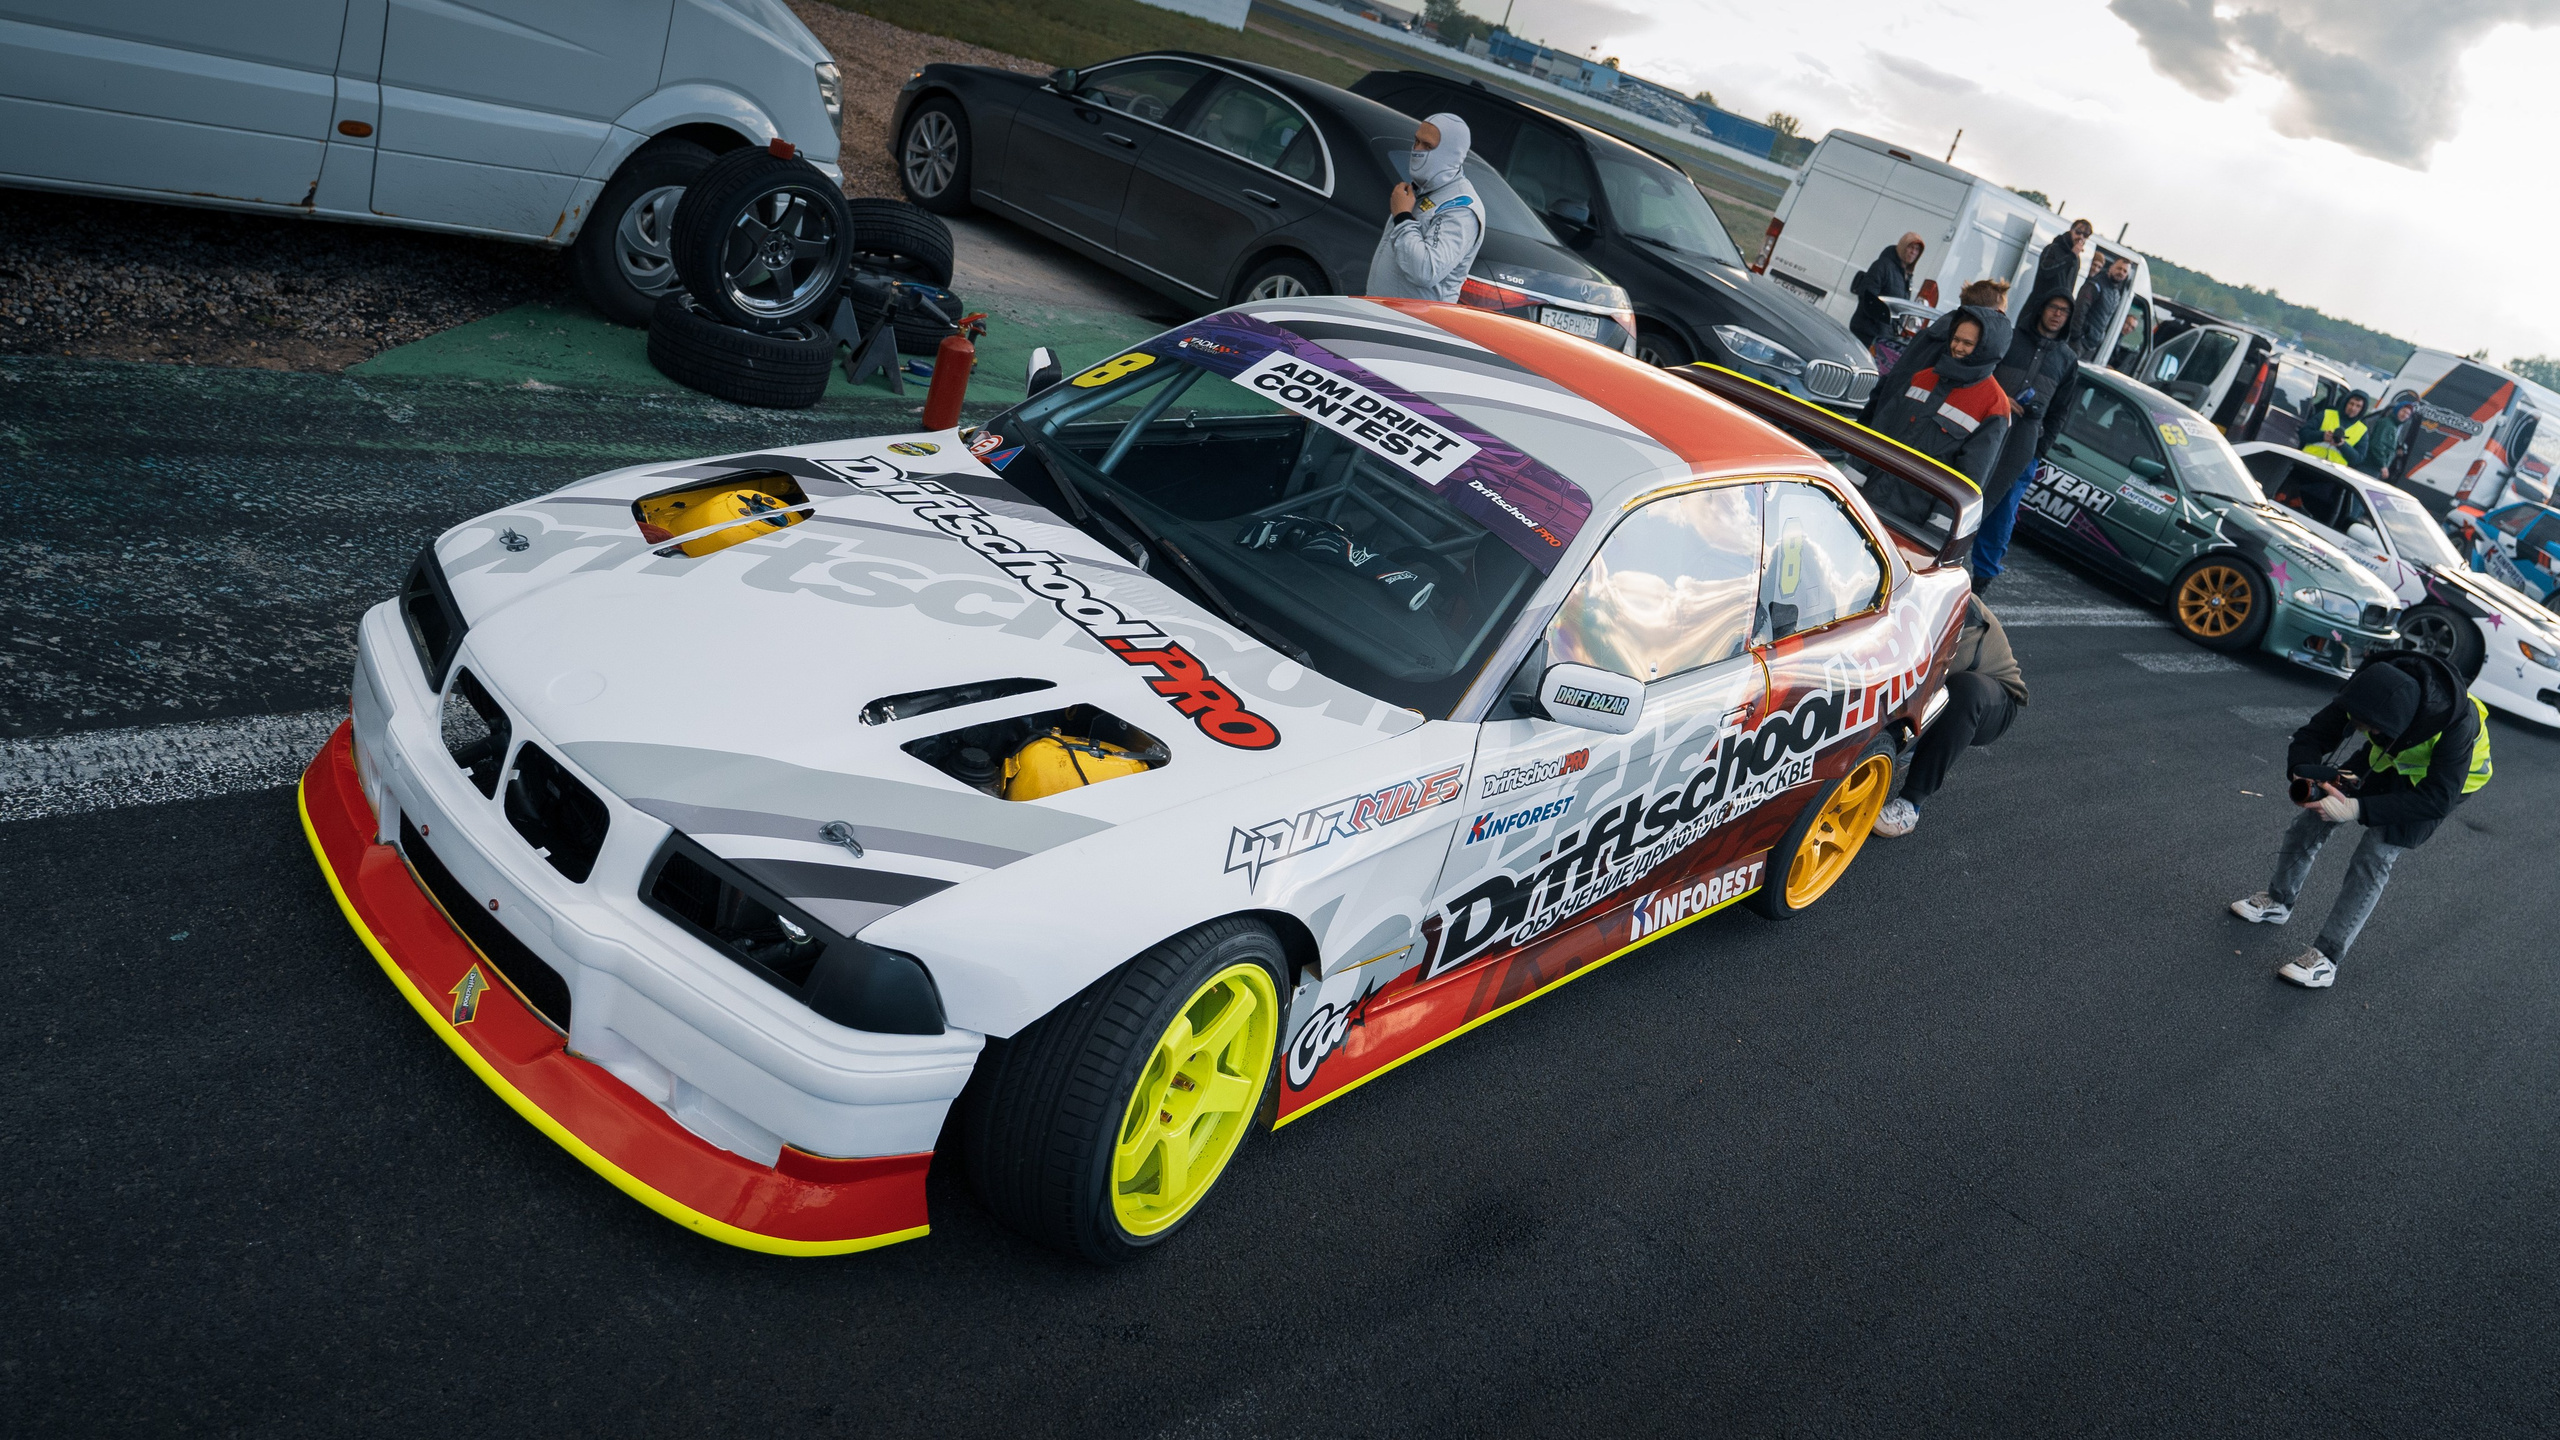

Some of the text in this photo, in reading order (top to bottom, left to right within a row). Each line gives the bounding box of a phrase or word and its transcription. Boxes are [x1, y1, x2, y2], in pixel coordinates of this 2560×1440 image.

[1506, 276, 1525, 285] 500
[1582, 317, 1597, 331] 797
[1071, 352, 1157, 388] 8
[1253, 373, 1443, 467] CONTEST
[1270, 362, 1461, 453] ADM DRIFT
[2159, 424, 2189, 447] 63
[1468, 479, 1562, 548] Driftschool.PRO
[2020, 483, 2075, 522] EAM
[2041, 465, 2112, 514] YEAH
[2119, 485, 2165, 514] KINFOREST
[1779, 516, 1803, 597] 8
[812, 456, 1283, 751] Driftschool.PRO
[1555, 687, 1630, 716] DRIFT BAZAR
[1432, 603, 1932, 975] Driftschool.PRO
[1482, 748, 1590, 799] Driftschool.PRO
[1466, 795, 1576, 845] KINFOREST
[1514, 861, 1636, 945] ОБУЧЕНИЕ
[1731, 756, 1814, 815] МОСКВЕ
[1629, 861, 1764, 943] KINFOREST
